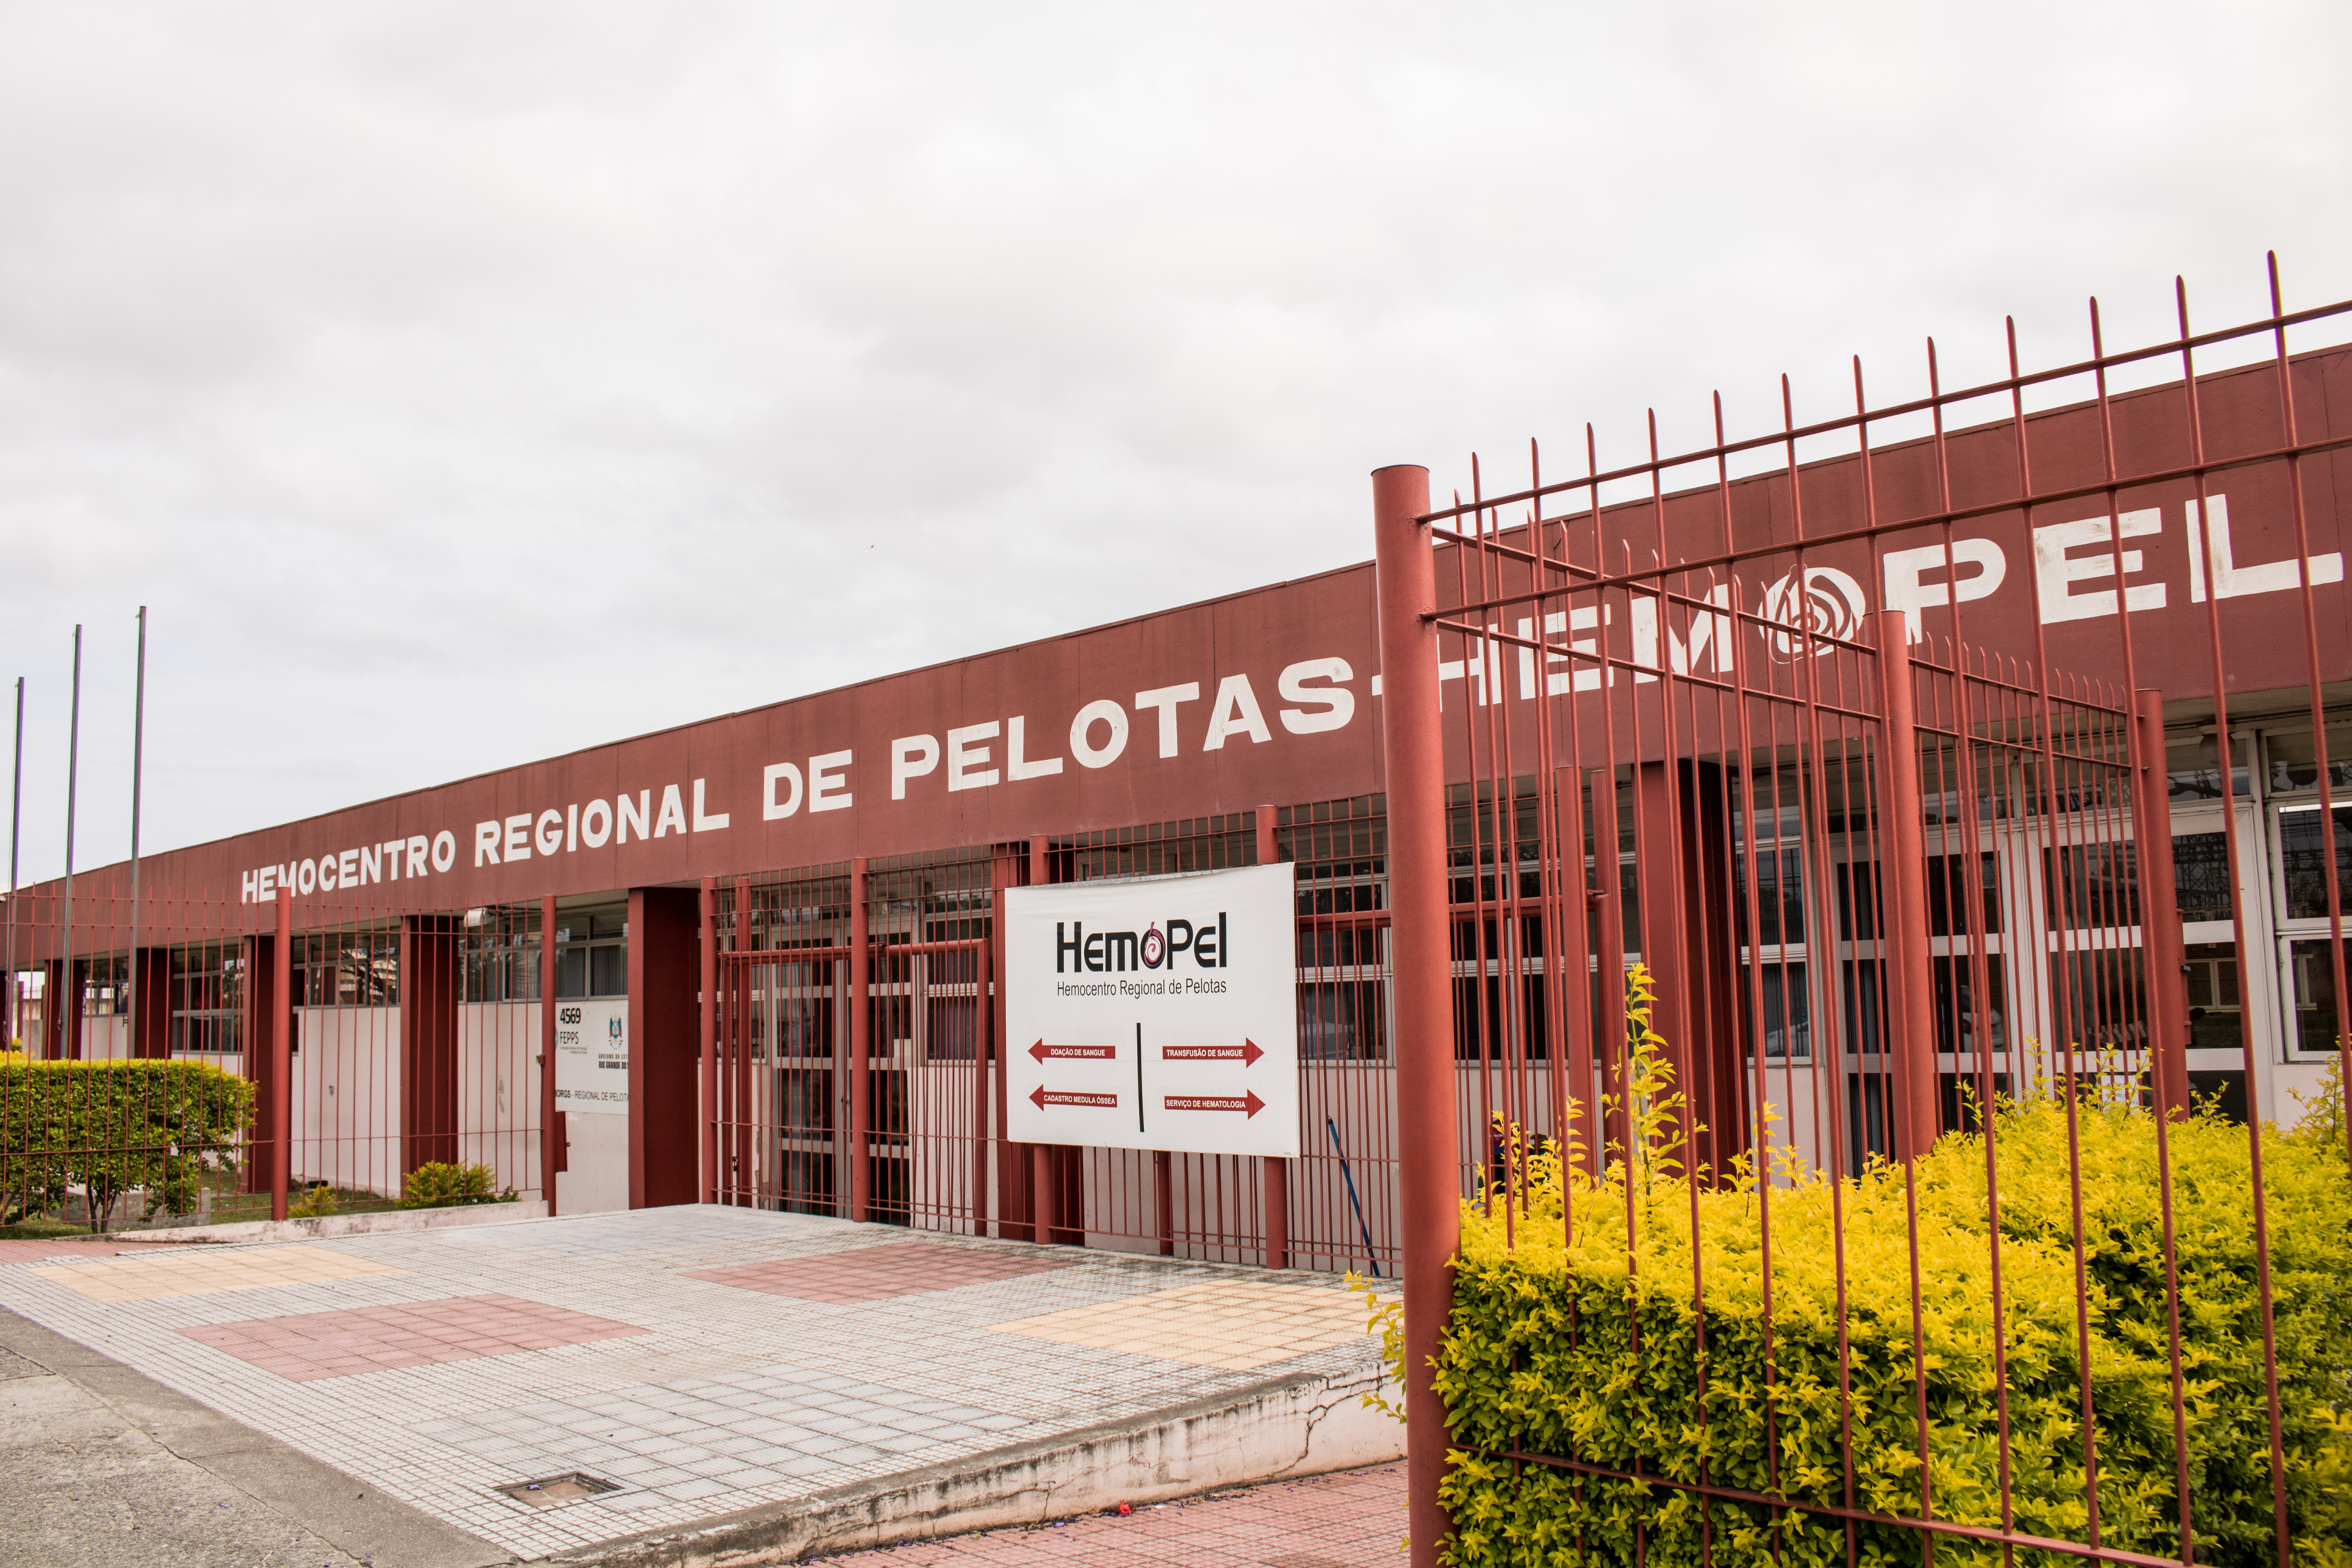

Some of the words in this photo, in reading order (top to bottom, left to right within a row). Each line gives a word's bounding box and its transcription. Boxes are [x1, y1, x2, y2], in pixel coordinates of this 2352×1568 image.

[242, 831, 456, 905] HEMOCENTRO
[475, 778, 730, 867] REGIONAL
[763, 749, 852, 821] DE
[891, 657, 1355, 800] PELOTAS
[1057, 982, 1117, 996] Hemocentro
[1120, 979, 1165, 999] Regional
[1169, 979, 1182, 995] de
[1186, 978, 1227, 994] Pelotas
[560, 1007, 581, 1024] 4569
[560, 1031, 579, 1044] FEPPS
[1051, 1047, 1074, 1057] DOAÇÃO
[1166, 1048, 1207, 1057] TRANSFUSÃO
[606, 1061, 621, 1069] GRANDE
[555, 1089, 570, 1098] ORGS
[574, 1090, 600, 1100] REGIONAL
[601, 1092, 608, 1101] DE
[1096, 1096, 1115, 1105] ÓSSEA
[1166, 1099, 1192, 1109] SERVIÇO
